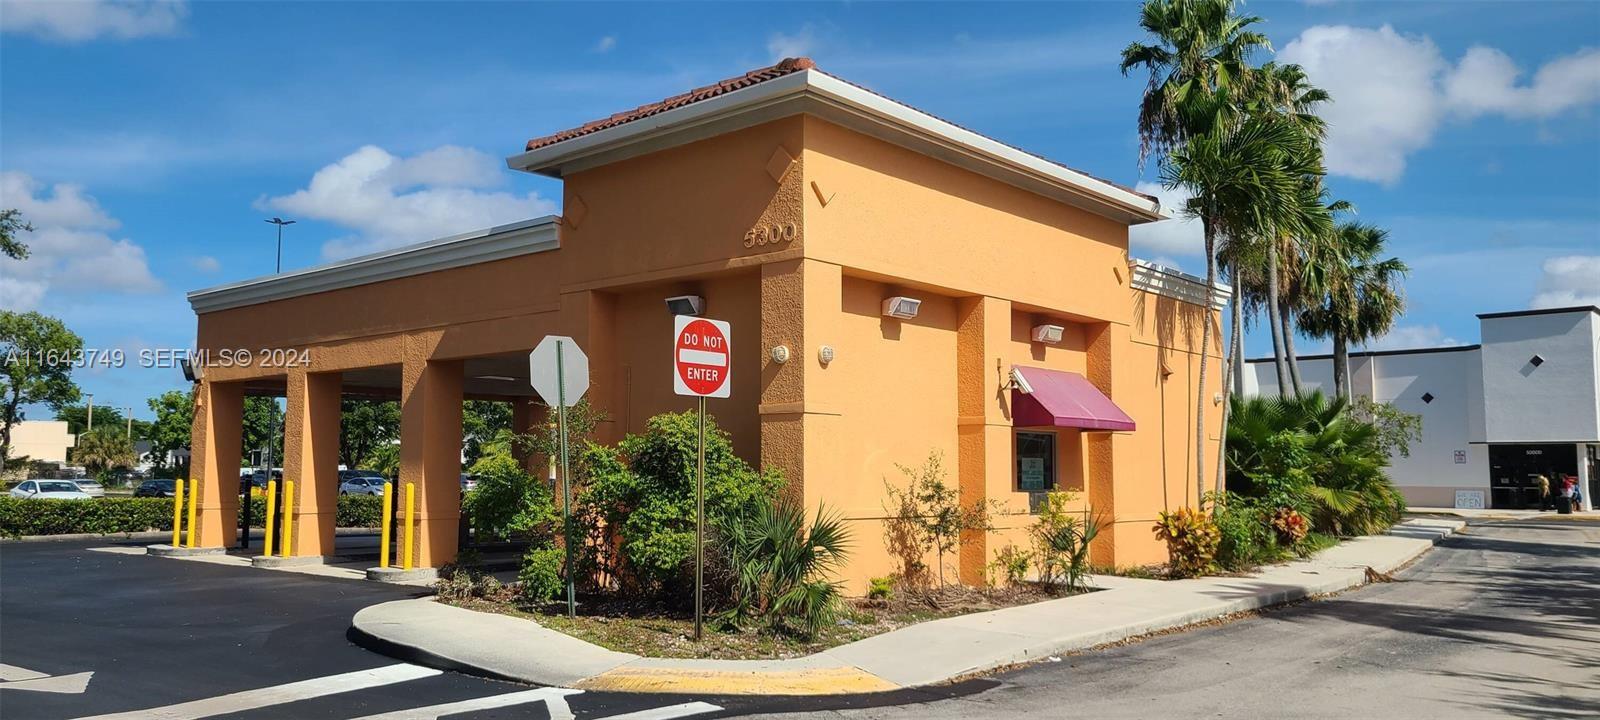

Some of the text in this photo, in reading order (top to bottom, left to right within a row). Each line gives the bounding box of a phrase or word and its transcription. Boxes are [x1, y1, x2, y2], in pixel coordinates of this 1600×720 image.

[744, 222, 797, 248] 5300
[684, 333, 723, 349] DO NOT
[687, 367, 719, 381] ENTER
[1456, 498, 1482, 508] OPEN
